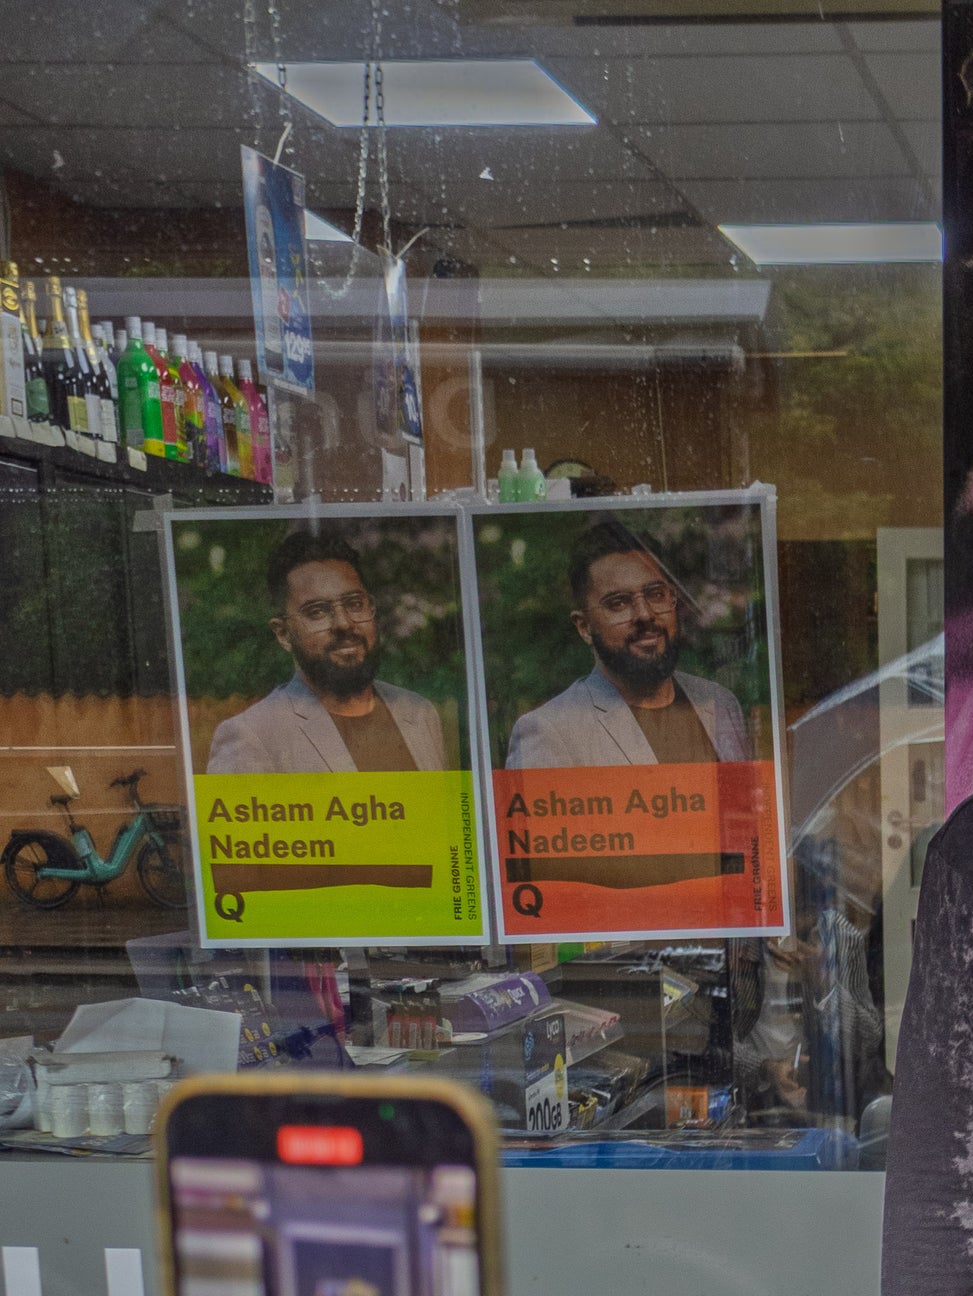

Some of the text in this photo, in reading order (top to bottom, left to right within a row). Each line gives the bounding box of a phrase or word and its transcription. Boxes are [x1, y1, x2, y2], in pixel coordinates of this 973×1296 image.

[208, 795, 405, 826] Asham Agha
[506, 787, 705, 818] Asham Agha
[210, 833, 335, 859] Nadeem
[460, 792, 478, 921] INDEPENDENT GREENS
[508, 828, 634, 854] Nadeem
[450, 845, 463, 920] FRIE GRØNNE
[214, 891, 245, 922] Q
[512, 884, 543, 918] Q
